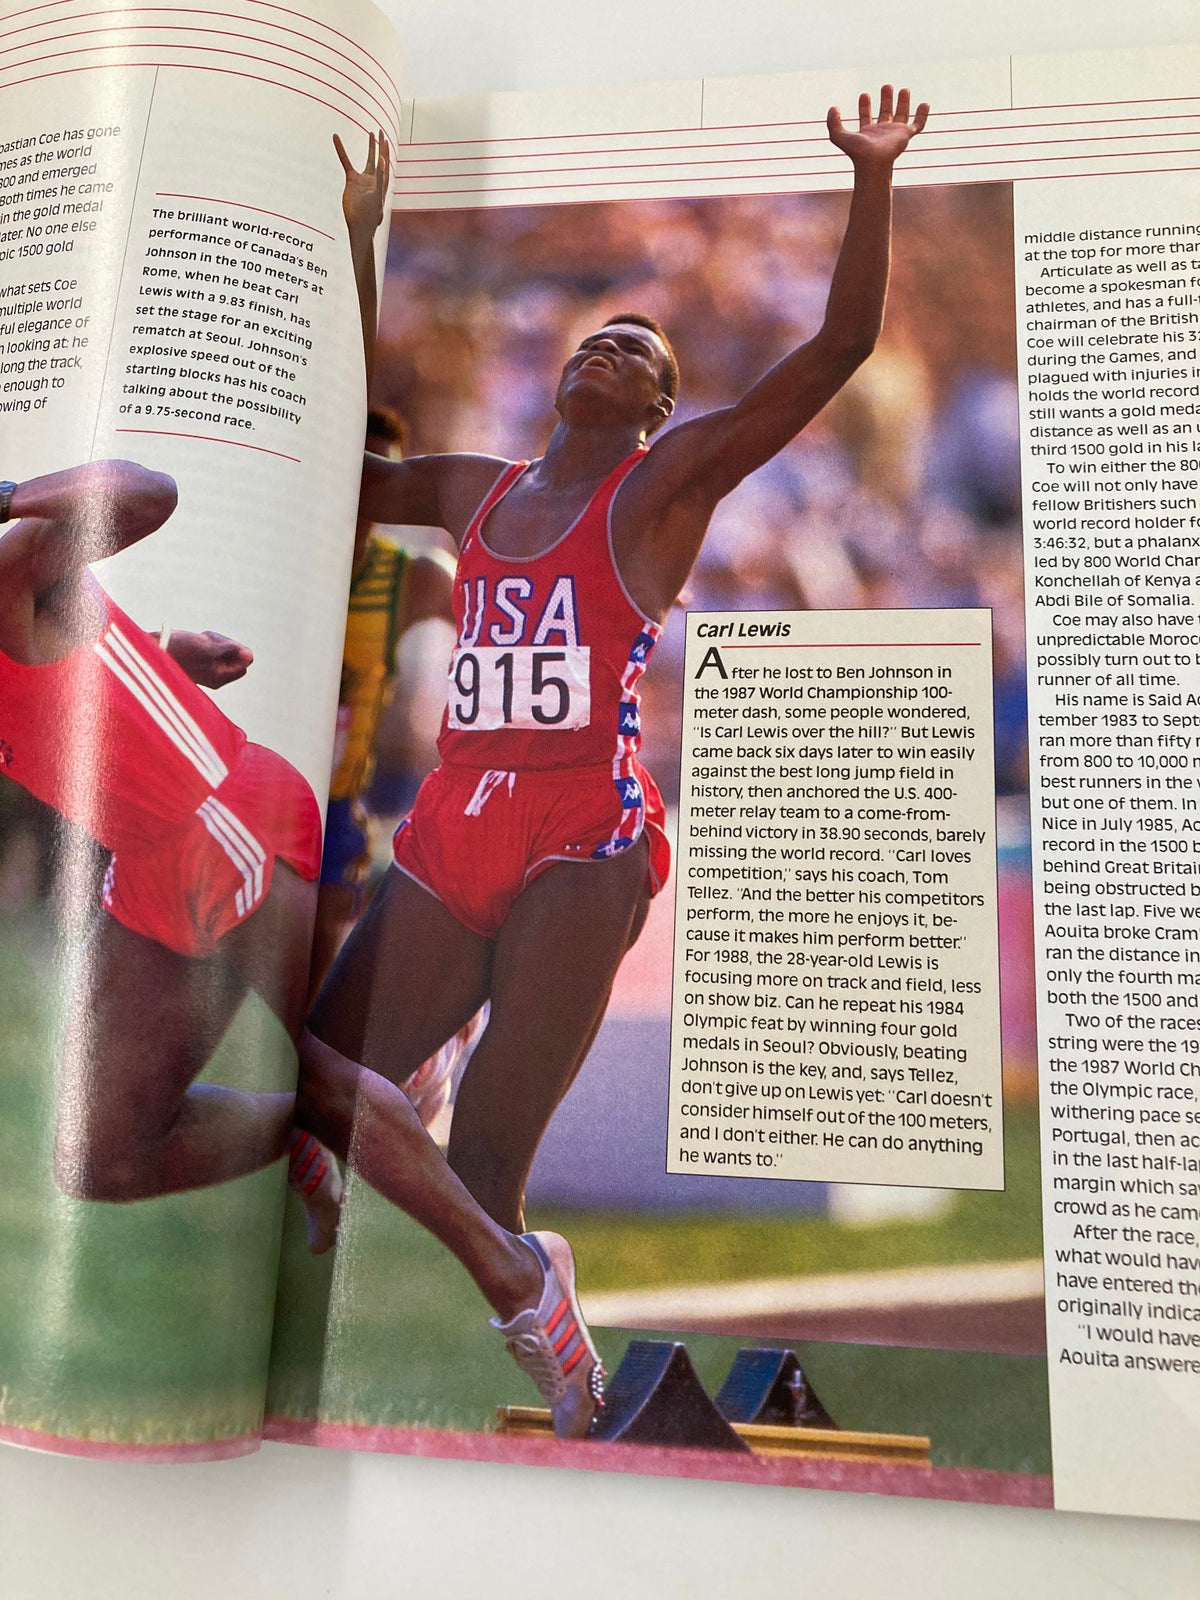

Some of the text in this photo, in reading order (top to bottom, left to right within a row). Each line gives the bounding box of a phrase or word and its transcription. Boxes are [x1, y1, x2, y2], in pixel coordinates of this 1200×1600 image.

[38, 126, 121, 145] Coe has gone
[19, 144, 93, 167] as the world
[17, 163, 97, 185] and emerged
[26, 182, 114, 202] times he came
[12, 200, 104, 223] the gold medal
[152, 208, 314, 253] The brilliant world-record
[17, 239, 75, 258] 1500 gold
[148, 229, 328, 279] performance of Canada's Ben
[145, 247, 325, 296] Johnson in the 100 meters at
[142, 266, 299, 305] Rome, when he beat Carl
[139, 285, 311, 329] Lewis with a 9.83 finish, has
[135, 305, 313, 350] set the stage for an exciting
[1026, 312, 1199, 331] chairman of the British
[132, 325, 308, 367] rematch at Seoul. Johnson's
[1027, 347, 1197, 367] during the Games, and
[129, 344, 296, 382] explosive speed out of the
[125, 363, 307, 406] starting blocks has his coach
[122, 383, 302, 425] talking about the possibility
[119, 403, 255, 431] of a 9.75-second race.
[1029, 440, 1189, 457] third 1500 gold in his
[1031, 497, 1197, 511] fellow Britishers such
[459, 575, 581, 648] USA
[1035, 593, 1195, 607] Abdi Bile of Somalia.
[696, 621, 792, 639] Carl Lewis
[762, 666, 782, 680] he
[785, 666, 814, 679] lost
[815, 666, 833, 679] to
[836, 666, 865, 679] Ben
[867, 665, 934, 679] Johnson
[937, 665, 952, 679] in
[1037, 673, 1181, 687] runner of all time.
[454, 653, 571, 726] 915
[693, 685, 953, 701] the 1987 World Championship 100-
[693, 705, 971, 721] meter dash, some people wondered,
[692, 745, 976, 761] came back six days later to win easily
[689, 824, 987, 845] behind victory in 38.90 seconds, barely
[685, 948, 939, 971] For 1988, the 28-year-old Lewis is
[1047, 989, 1199, 1008] both the 1500 and
[681, 1057, 958, 1086] Johnson is the key, and, says Tellez,
[1049, 1080, 1198, 1103] the Olympic race,
[1073, 1223, 1199, 1249] After the race,
